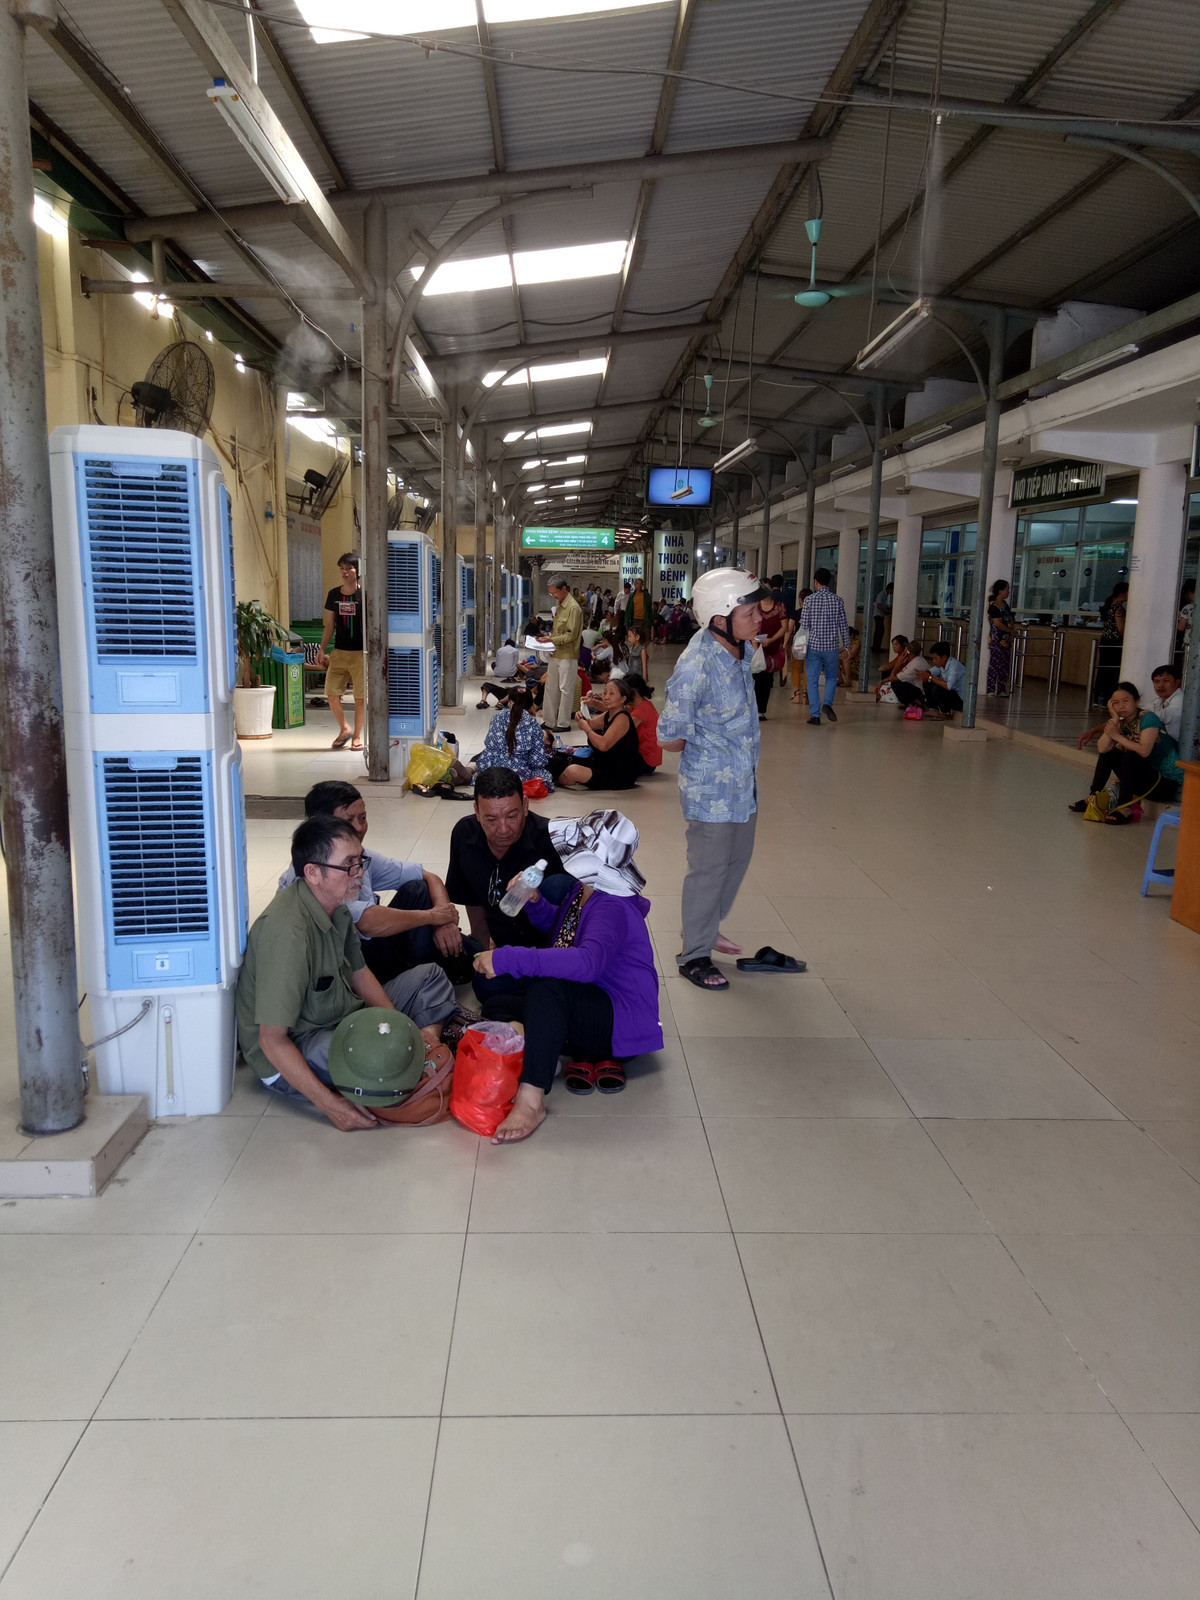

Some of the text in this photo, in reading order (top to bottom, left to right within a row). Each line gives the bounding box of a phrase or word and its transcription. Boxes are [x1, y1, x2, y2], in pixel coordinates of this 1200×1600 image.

[1027, 468, 1041, 499] TIẾP
[1058, 465, 1079, 497] BỆNH
[601, 536, 609, 546] 4
[664, 533, 684, 547] NHÀ
[625, 555, 639, 564] NHÀ
[658, 549, 689, 564] THUỐC
[622, 564, 643, 575] THUỐC
[660, 567, 686, 584] BỆNH
[661, 585, 683, 601] VIỆN
